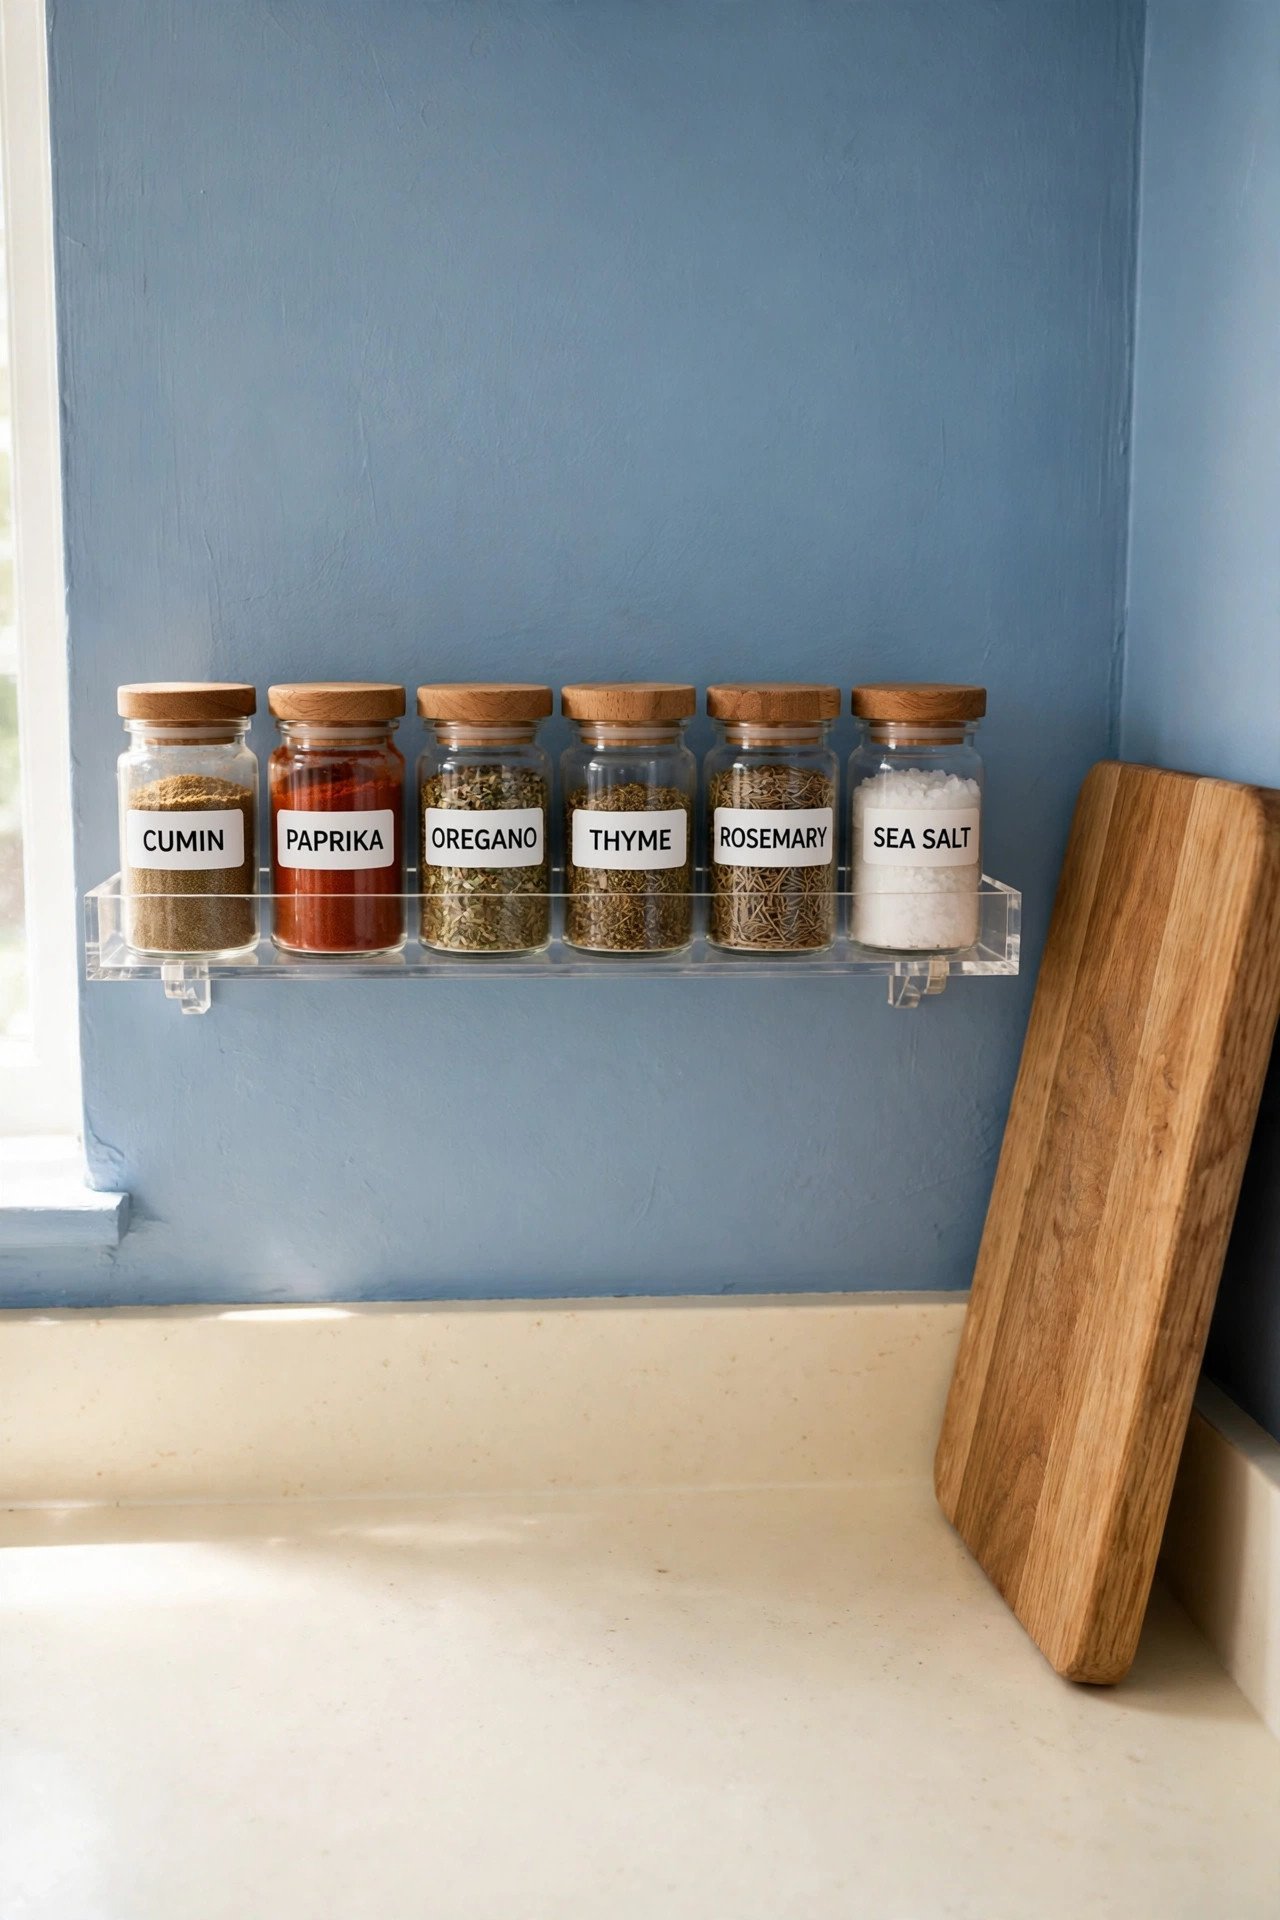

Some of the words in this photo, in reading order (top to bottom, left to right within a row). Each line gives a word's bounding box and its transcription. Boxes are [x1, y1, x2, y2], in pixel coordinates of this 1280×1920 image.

[143, 829, 224, 852] CUMIN
[286, 829, 384, 852] PAPRIKA
[431, 827, 538, 850] OREGANO
[589, 828, 672, 851] THYME
[720, 826, 828, 849] ROSEMARY
[873, 827, 916, 849] SEA
[922, 827, 972, 849] SALT
